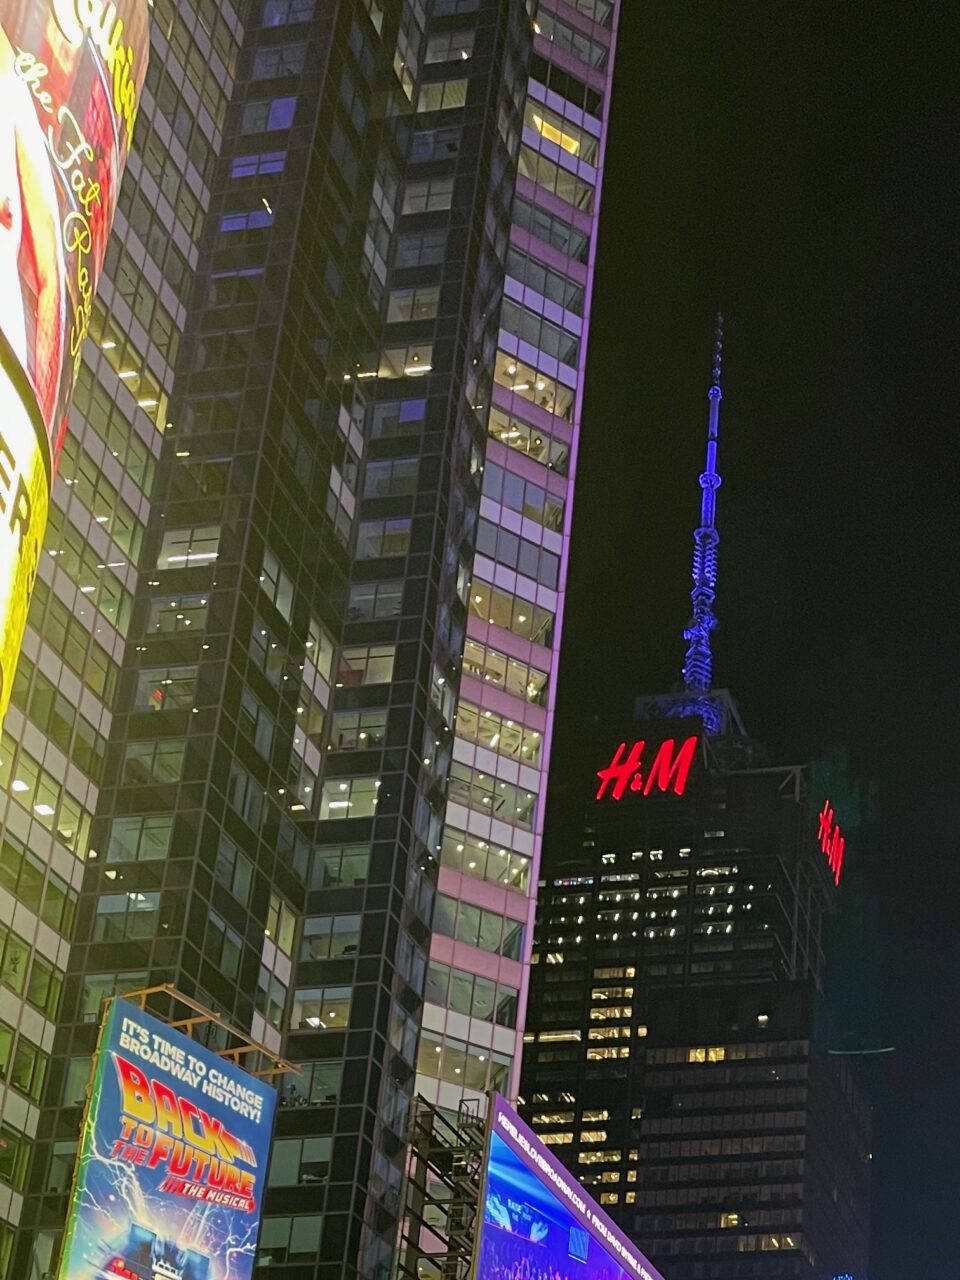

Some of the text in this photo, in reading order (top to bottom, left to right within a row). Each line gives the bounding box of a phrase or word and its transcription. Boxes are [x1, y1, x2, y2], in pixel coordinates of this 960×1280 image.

[596, 736, 698, 800] H&M
[119, 1033, 261, 1124] BROADWAY HISTORY!
[122, 1017, 263, 1109] IT'S TIME TO CHANGE
[114, 1053, 257, 1167] BACK
[120, 1116, 152, 1146] TO
[111, 1131, 256, 1197] THE FUTURE
[182, 1182, 251, 1210] THE MUSICAL
